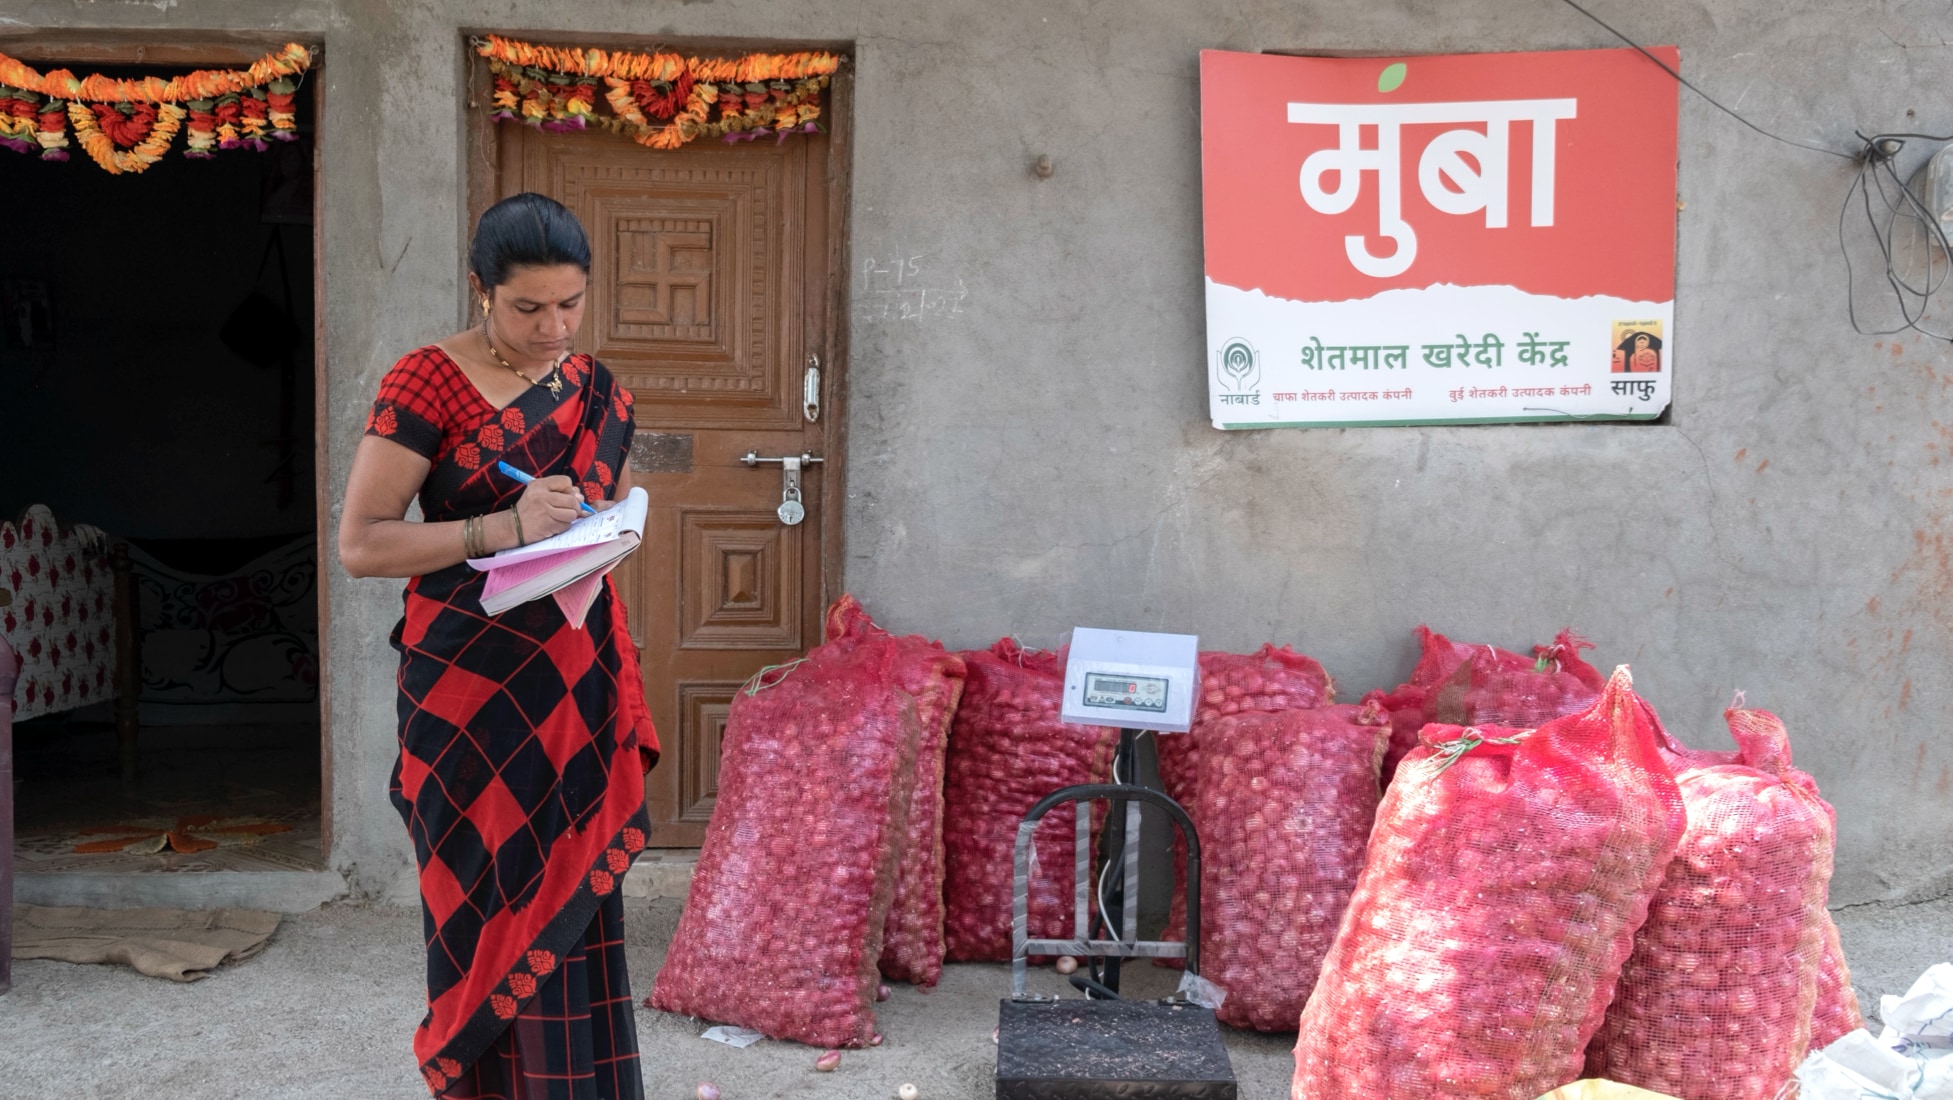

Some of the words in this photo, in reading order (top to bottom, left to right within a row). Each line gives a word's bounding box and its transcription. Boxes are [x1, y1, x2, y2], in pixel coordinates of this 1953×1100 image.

[1300, 336, 1410, 370] शेतमाल
[1421, 333, 1505, 369] खरेदी
[1516, 331, 1571, 368] केंद्र
[1218, 390, 1261, 405] नाबार्ड
[1301, 389, 1336, 402] शेतकरी
[1339, 391, 1379, 402] उत्पादक
[1382, 387, 1413, 401] कंपनी
[1468, 385, 1508, 399] शेतकरी
[1512, 387, 1555, 399] उत्पादक
[1559, 383, 1592, 396] कंपनी
[1610, 379, 1657, 402] साफु
